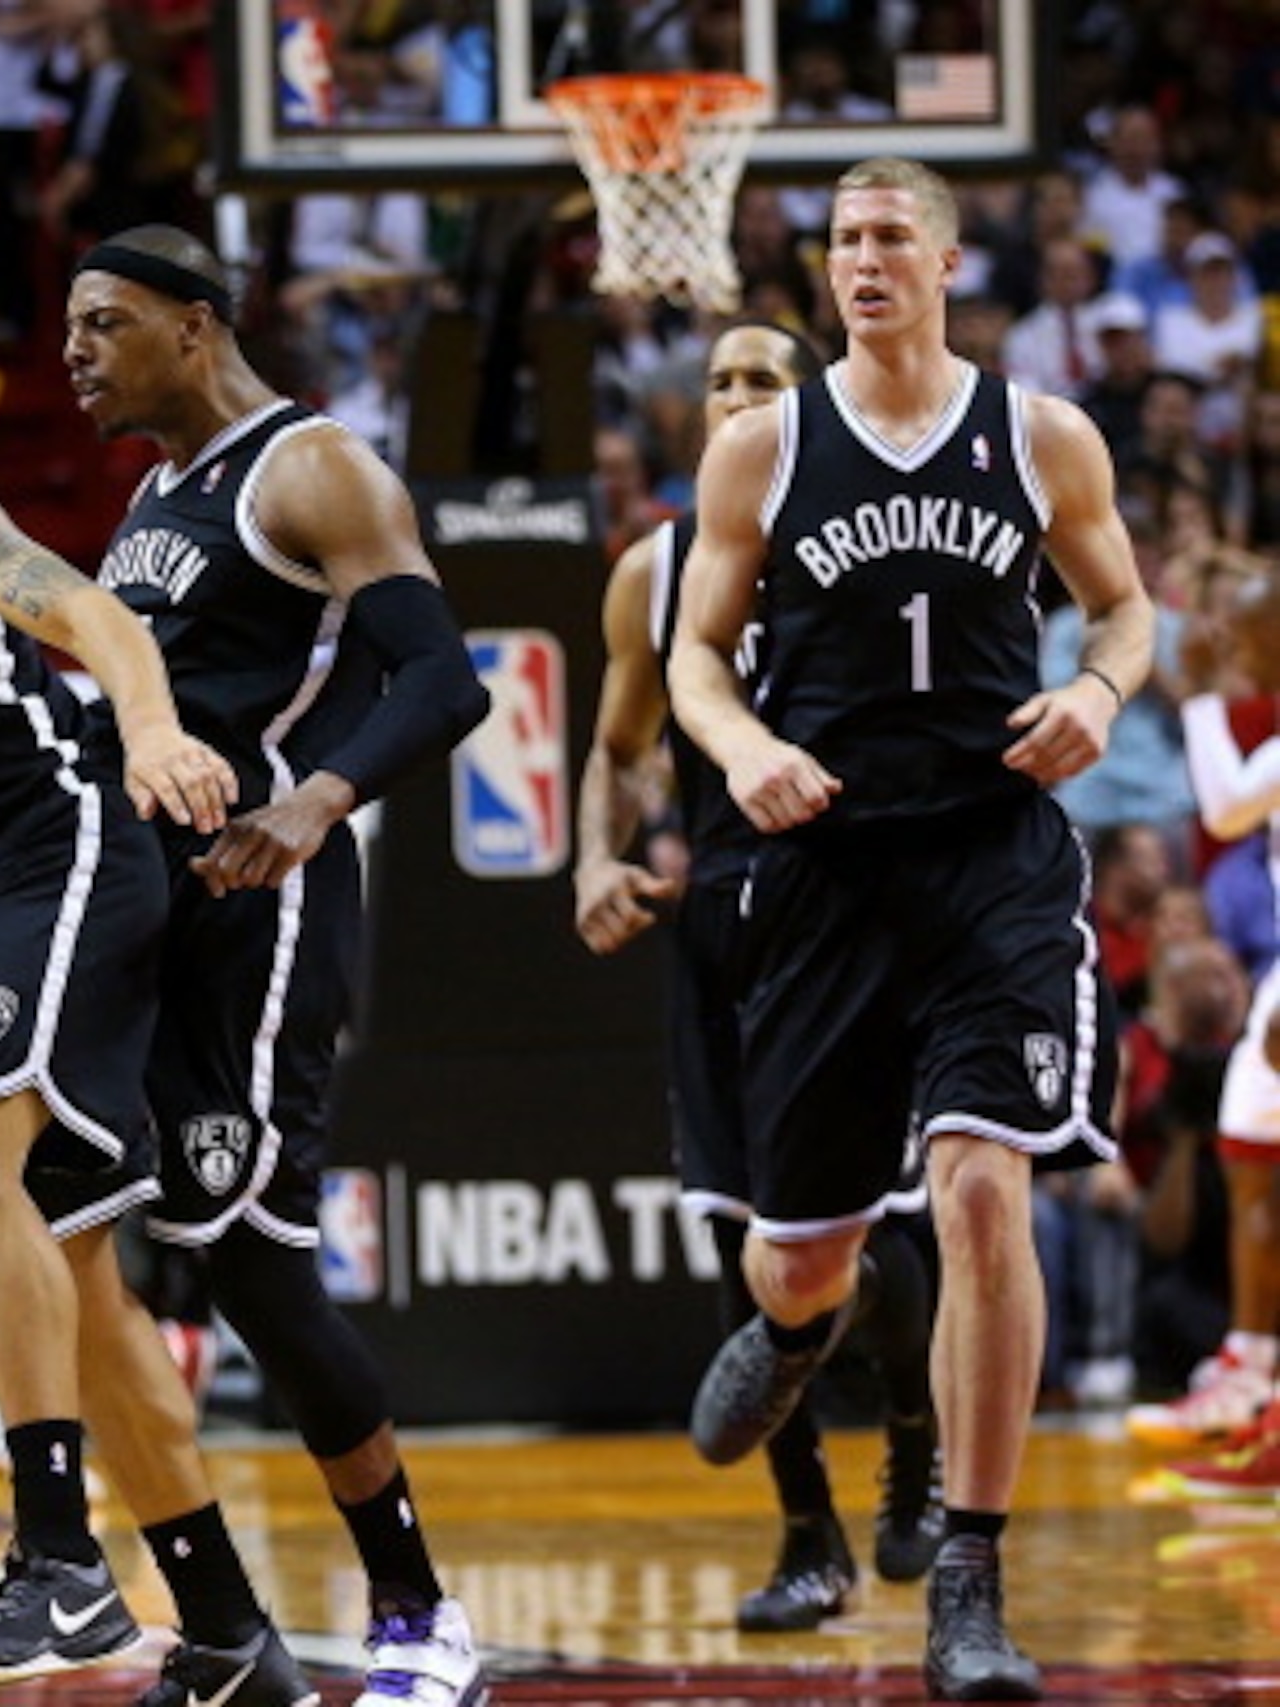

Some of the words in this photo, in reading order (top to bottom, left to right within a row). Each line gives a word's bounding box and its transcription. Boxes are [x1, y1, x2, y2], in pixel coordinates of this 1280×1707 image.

[794, 495, 1024, 588] BROOKLYN
[899, 593, 932, 692] 1
[418, 1178, 610, 1284] NBA
